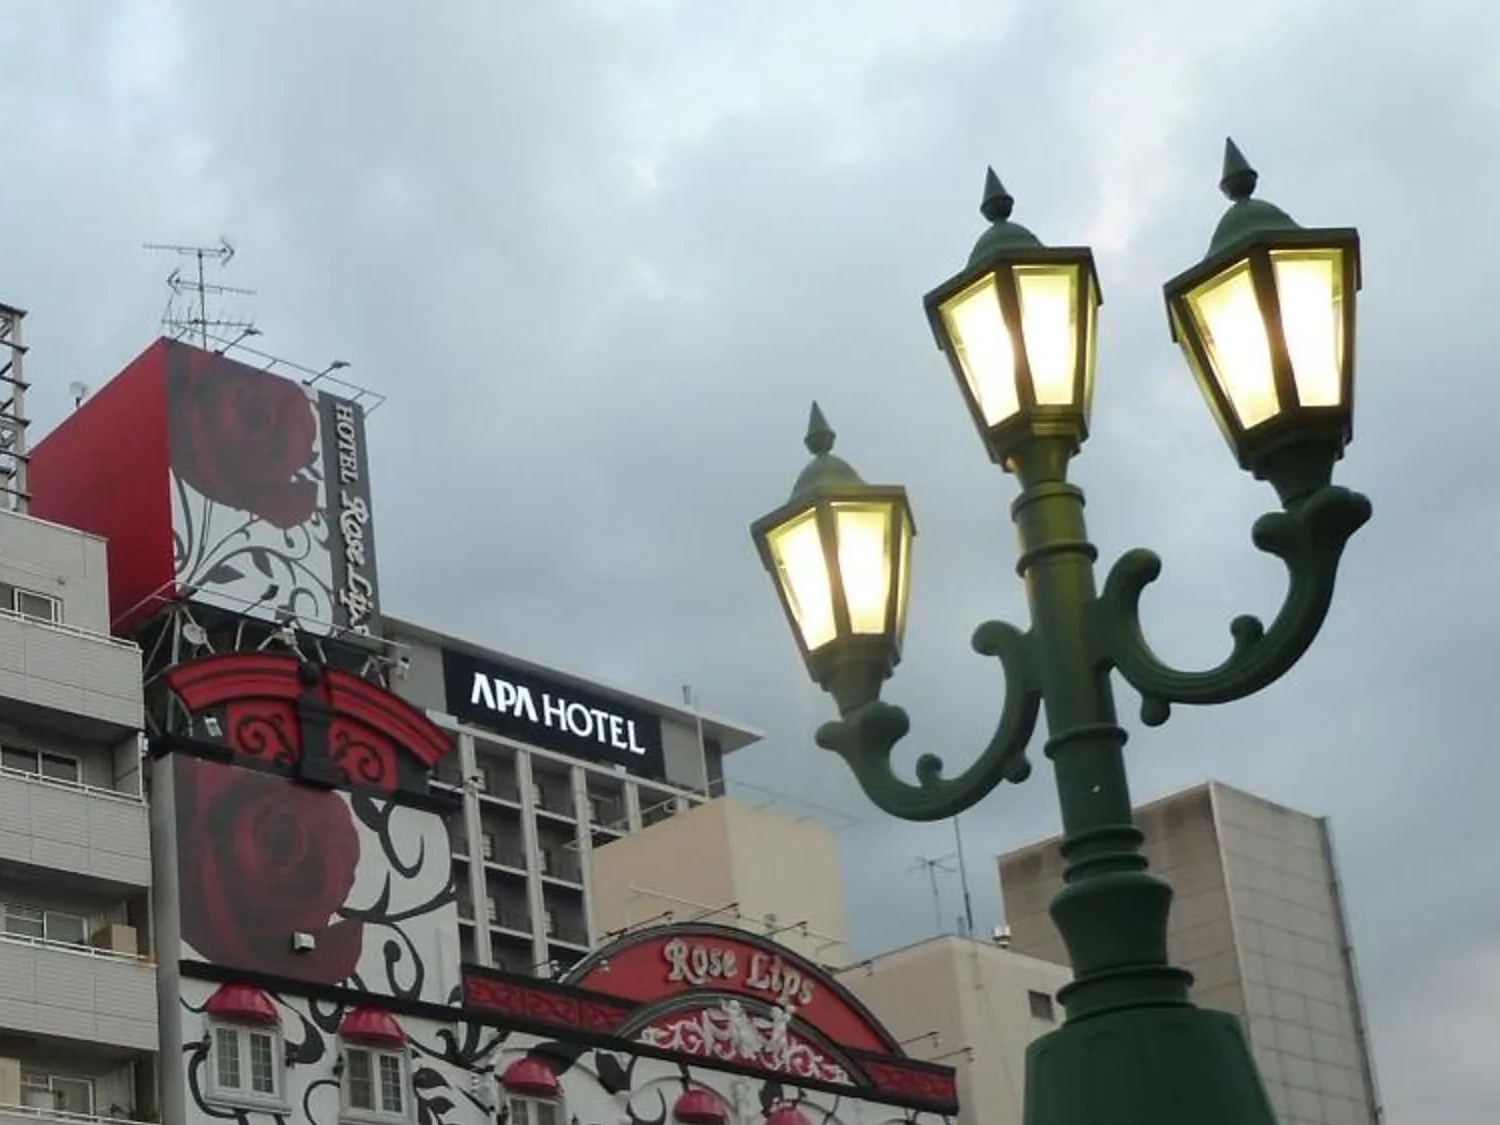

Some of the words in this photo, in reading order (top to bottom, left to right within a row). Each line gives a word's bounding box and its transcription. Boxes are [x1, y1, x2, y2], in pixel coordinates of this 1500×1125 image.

[335, 402, 359, 484] HOTEL
[339, 489, 370, 567] Rose
[471, 671, 539, 722] APA
[541, 693, 646, 755] HOTEL
[663, 937, 739, 985] Rose
[745, 950, 816, 1005] Lips
